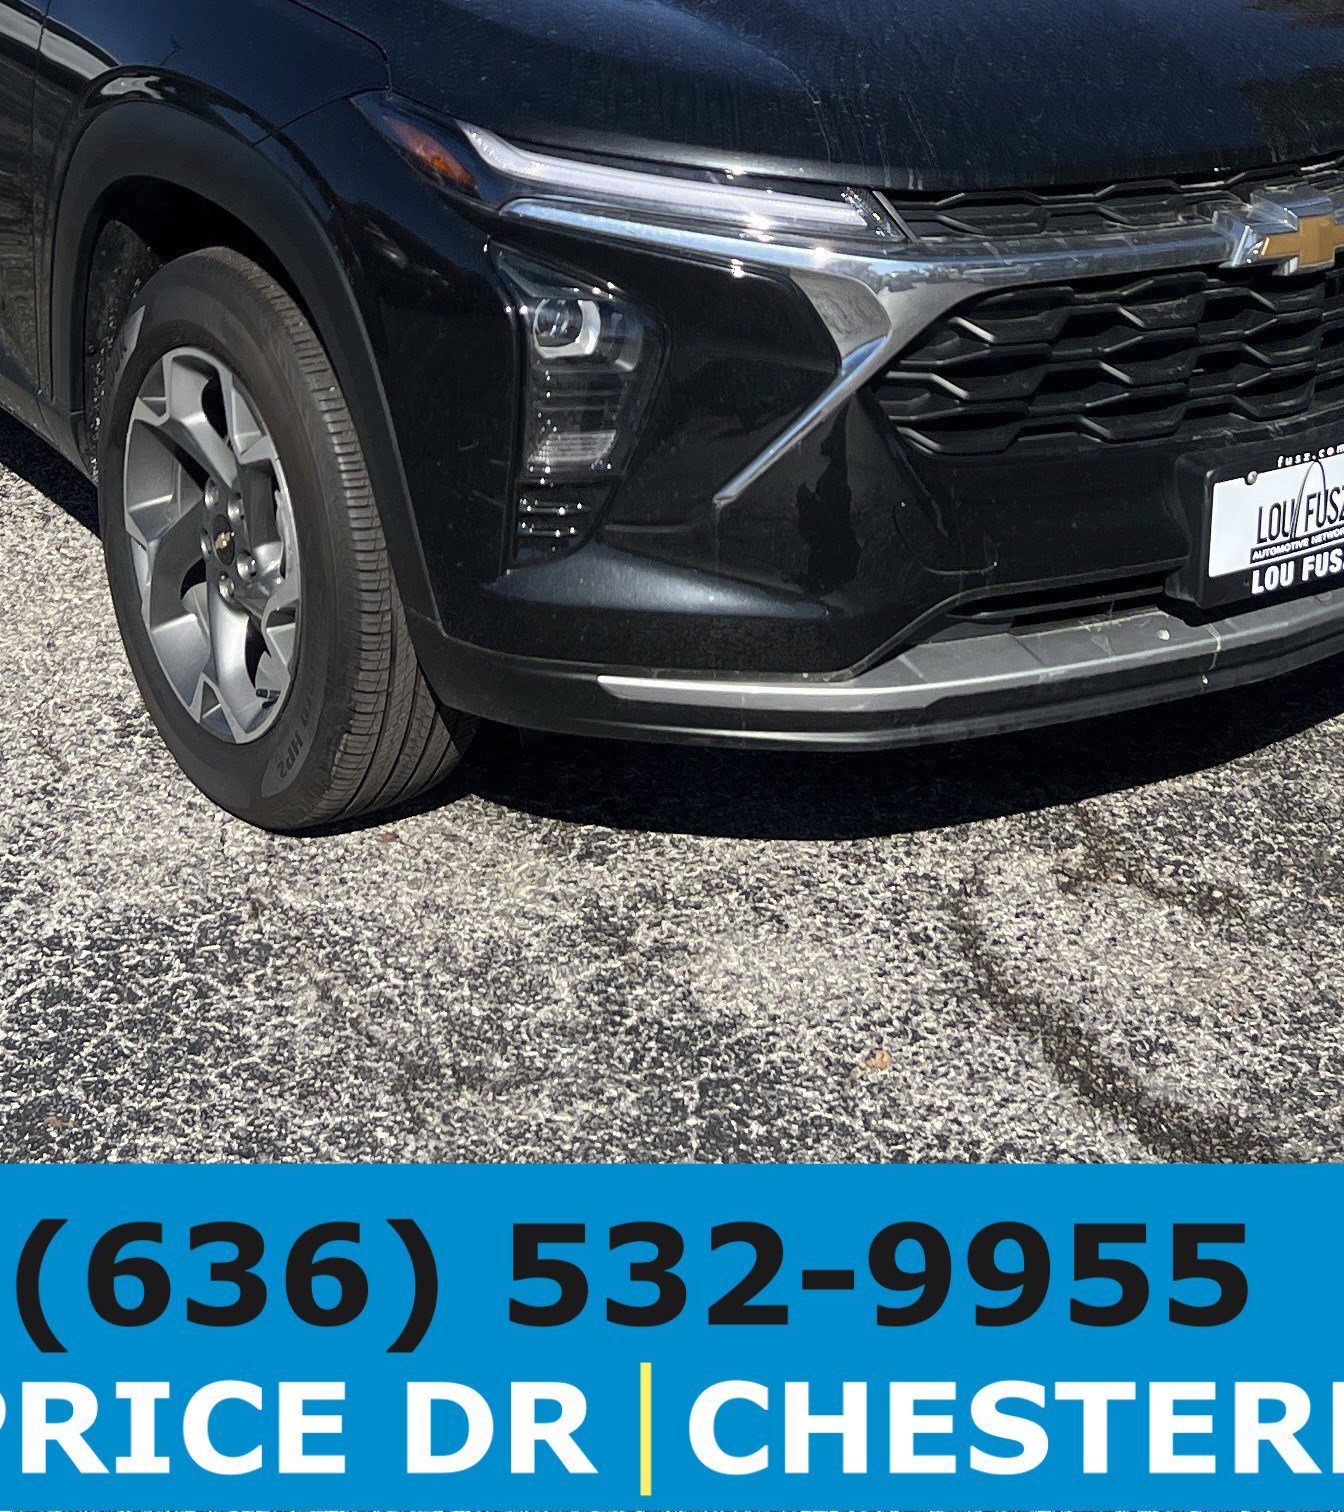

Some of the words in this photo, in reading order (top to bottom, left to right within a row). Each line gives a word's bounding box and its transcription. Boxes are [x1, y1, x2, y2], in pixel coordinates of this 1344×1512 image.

[1257, 498, 1296, 544] LOU
[1251, 537, 1309, 561] AUTOMOTIVE
[1251, 561, 1295, 595] LOU
